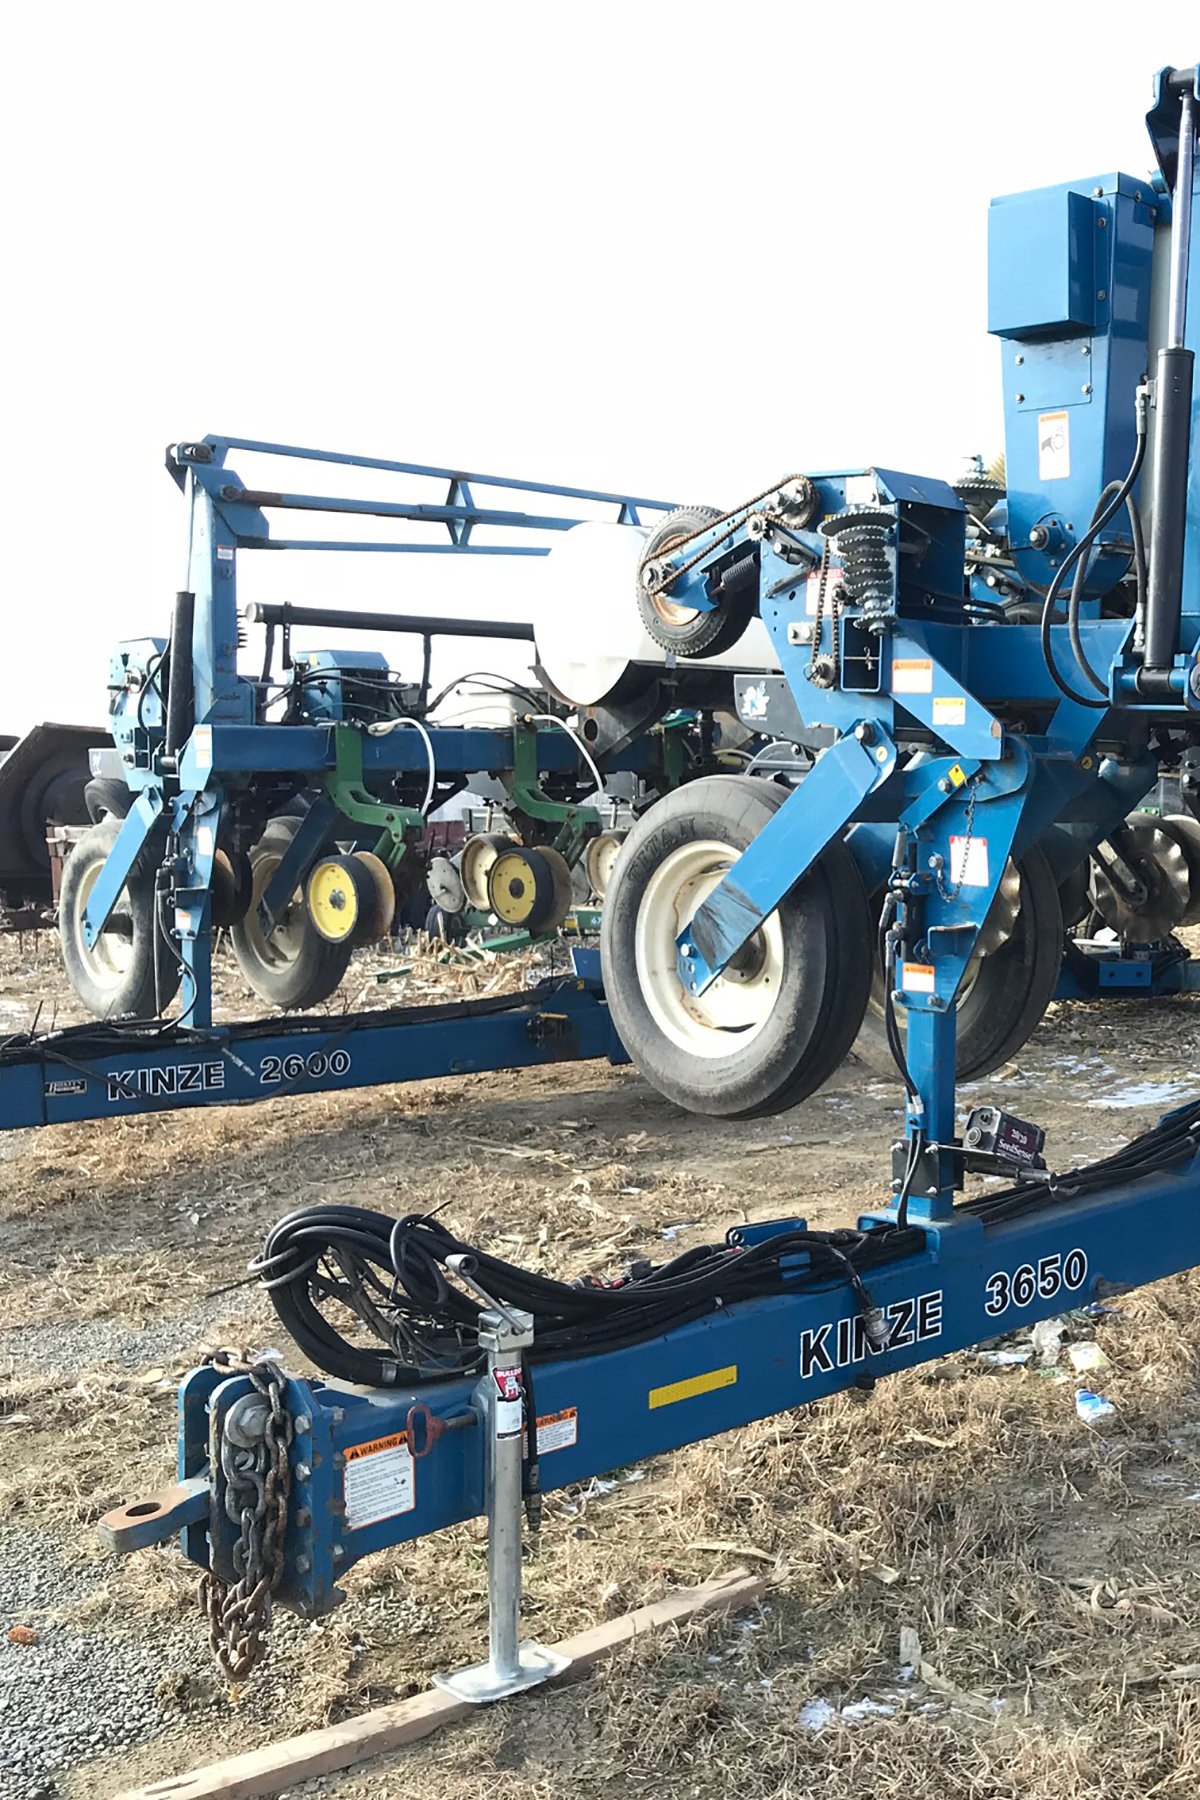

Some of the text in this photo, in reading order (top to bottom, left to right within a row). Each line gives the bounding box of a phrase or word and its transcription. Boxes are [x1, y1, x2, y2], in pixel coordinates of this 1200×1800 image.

[106, 1061, 225, 1101] KINZE
[259, 1050, 351, 1084] 2600
[799, 1248, 1088, 1379] KINZE 3650
[360, 1437, 398, 1456] WARNING
